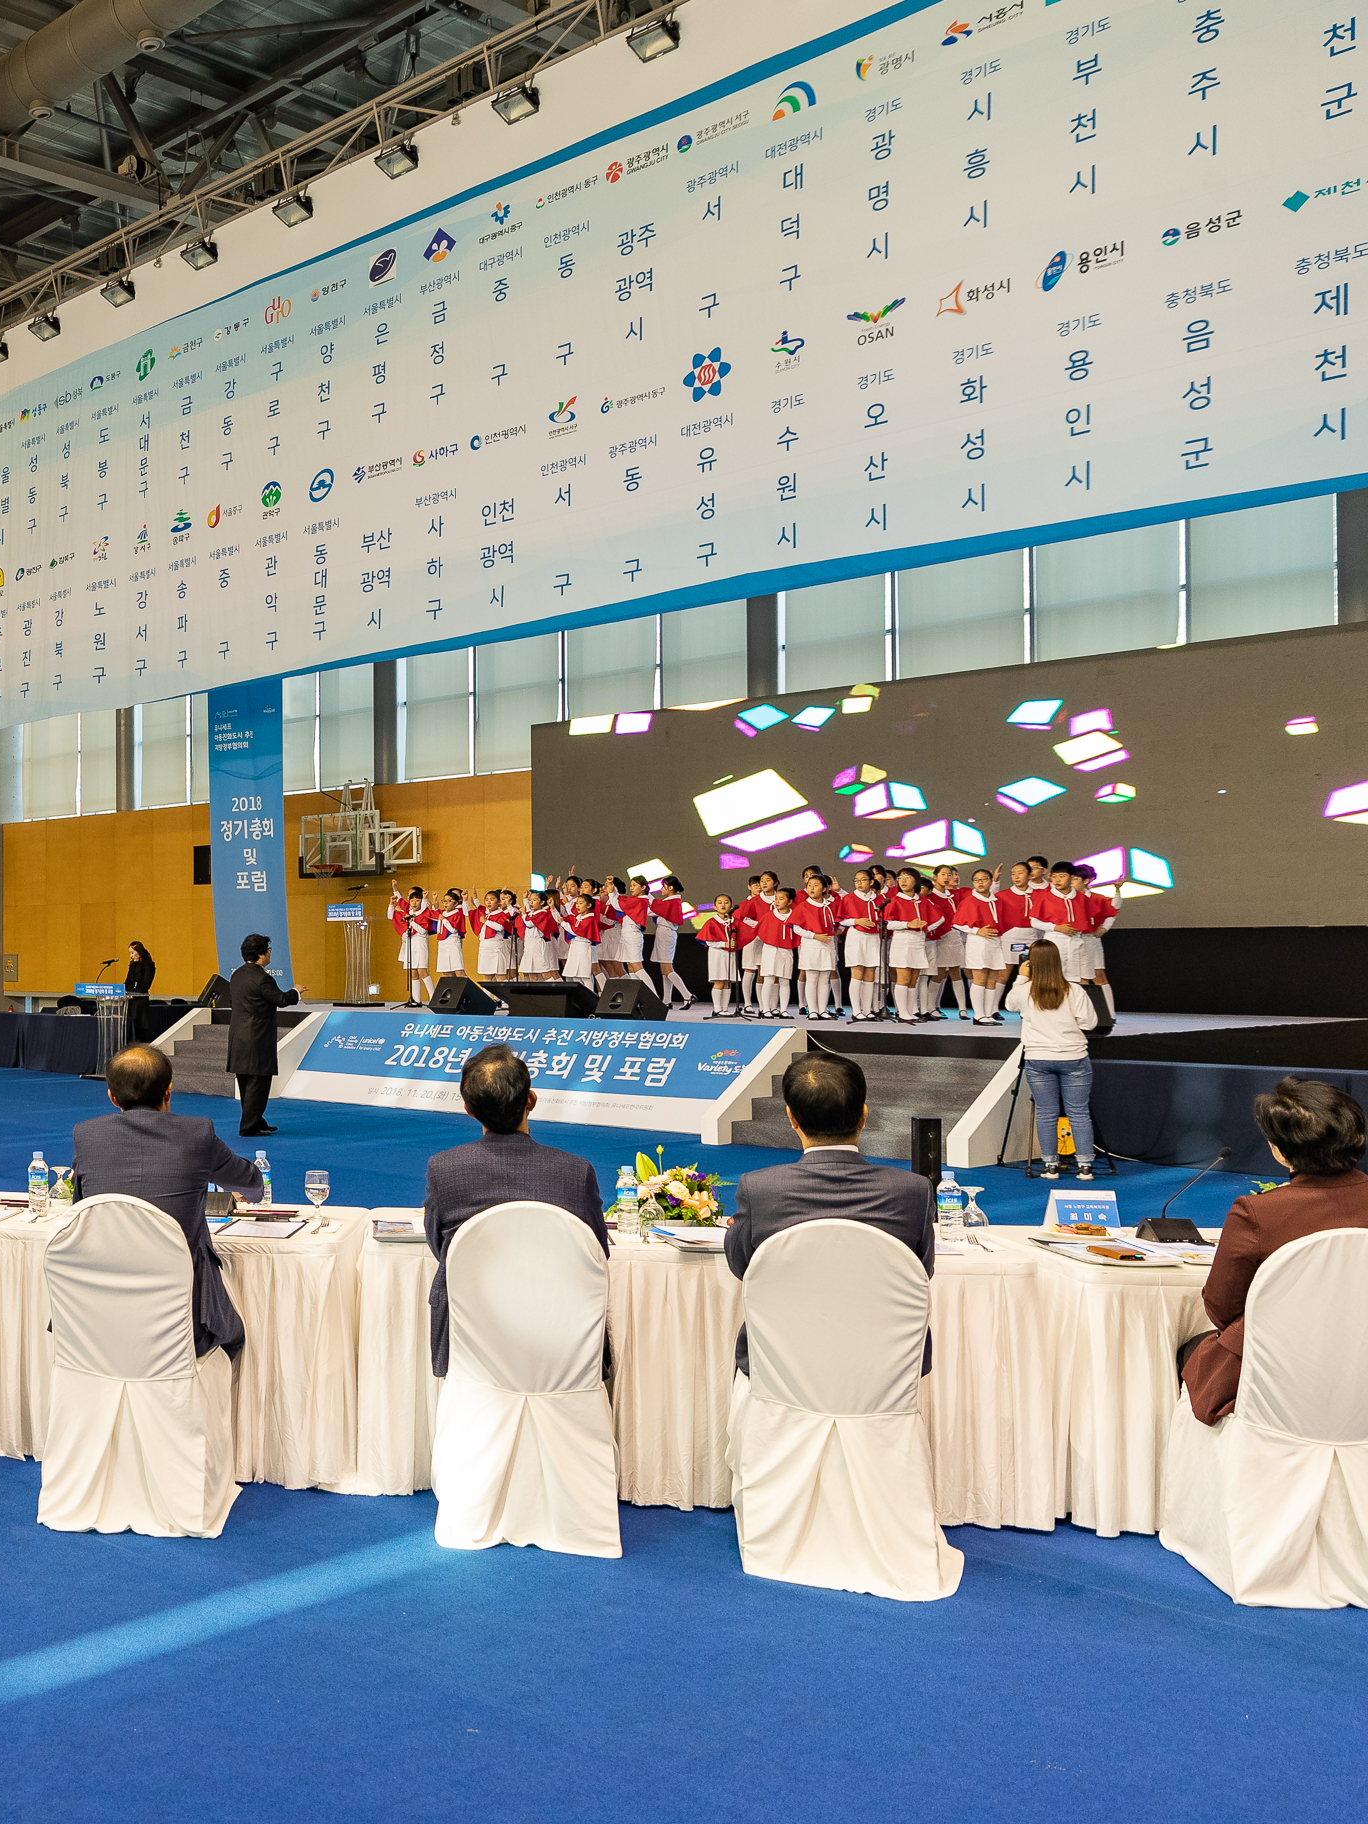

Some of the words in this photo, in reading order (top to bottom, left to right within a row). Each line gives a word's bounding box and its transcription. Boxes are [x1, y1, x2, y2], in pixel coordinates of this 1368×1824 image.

[1066, 16, 1112, 44] 경기도
[878, 50, 914, 75] 광명시
[960, 58, 1002, 86] 경기도
[1188, 8, 1226, 156] 충주시
[864, 98, 902, 122] 경기도
[1070, 54, 1102, 194] 부천시
[697, 117, 732, 139] 광주광역시
[735, 110, 749, 121] 서구
[627, 143, 668, 168] 광주광역시
[766, 126, 822, 158] 대전광역시
[627, 160, 655, 175] GWANGJU
[657, 154, 668, 163] CITY
[962, 92, 992, 228] 시흥시
[686, 160, 738, 194] 광주광역시
[1314, 178, 1368, 198] 제천
[866, 130, 896, 260] 광명시
[544, 220, 590, 248] 인천광역시
[616, 222, 656, 256] 광주
[780, 162, 804, 292] 대덕구
[1184, 210, 1242, 240] 음성군
[480, 246, 522, 272] 대구광역시
[698, 196, 720, 318] 서구
[1077, 240, 1124, 274] 용인시
[420, 270, 460, 296] 부산광역시
[614, 268, 652, 302] 광역
[966, 278, 1010, 302] 화성시
[1164, 278, 1232, 308] 충청북도
[362, 292, 402, 316] 서울특별시
[556, 252, 576, 366] 동구
[310, 314, 346, 336] 서울특별시
[490, 278, 510, 386] 중구
[626, 316, 642, 340] 시
[858, 326, 894, 345] OSAN
[1056, 312, 1102, 338] 경기도
[260, 334, 294, 354] 서울특별시
[430, 300, 448, 406] 금정구
[952, 342, 994, 364] 경기도
[216, 352, 246, 372] 서울특별시
[372, 322, 390, 424] 은평구
[1314, 282, 1348, 440] 제천시
[172, 370, 202, 390] 서울특별시
[316, 342, 334, 440] 양천구
[858, 368, 894, 390] 경기도
[132, 388, 158, 406] 서울특별시
[266, 362, 284, 456] 구로구
[772, 394, 806, 414] 경기도
[1180, 320, 1214, 470] 음성군
[56, 418, 80, 434] 서울특별시
[90, 404, 118, 420] 서울특별시
[222, 378, 236, 470] 강동구
[680, 412, 734, 438] 대전광역시
[1064, 350, 1094, 490] 용인시
[22, 432, 46, 450] 서울특별시
[178, 396, 194, 484] 금천구
[484, 424, 526, 444] 인천광역시
[608, 434, 656, 458] 광주광역시
[960, 374, 988, 512] 화성시
[138, 410, 150, 498] 서대문구
[368, 457, 402, 473] 부산광역시
[429, 444, 458, 460] 사하구
[540, 454, 586, 476] 인천광역시
[58, 440, 70, 522] 성북구
[96, 428, 110, 510] 도봉구
[864, 404, 888, 530] 오산시
[28, 454, 38, 534] 성동구
[414, 488, 456, 508] 부산광역시
[776, 426, 800, 548] 수원시
[482, 498, 514, 526] 인천
[696, 448, 718, 568] 유성구
[302, 518, 340, 536] 서울특별시
[622, 466, 642, 582] 동구
[208, 544, 240, 560] 서울특별시
[254, 530, 288, 548] 서울특별시
[360, 528, 392, 554] 부산
[554, 484, 572, 596] 서구
[168, 556, 196, 572] 서울특별시
[426, 516, 444, 620] 사하구
[480, 540, 514, 568] 광역
[86, 578, 116, 592] 서울특별시
[128, 568, 156, 582] 서울특별시
[360, 566, 390, 592] 광역
[16, 598, 40, 612] 서울특별시
[48, 586, 72, 602] 서울특별시
[264, 556, 278, 650] 관악구
[312, 544, 328, 640] 동대문구
[490, 584, 504, 608] 시
[176, 580, 188, 668] 송파구
[218, 568, 230, 660] 중구
[368, 608, 382, 630] 시
[92, 602, 106, 684] 노원구
[134, 590, 148, 676] 강서구
[20, 618, 32, 698] 광진구
[52, 608, 64, 690] 강북구
[232, 796, 262, 812] 2018
[221, 818, 274, 842] 정기총회
[244, 848, 257, 865] 및
[236, 871, 267, 892] 포럼
[401, 1023, 453, 1038] 유니세프
[456, 1025, 541, 1044] 아동친화도시
[542, 1028, 574, 1046] 추진
[575, 1030, 689, 1049] 지방정부협의회
[384, 1044, 472, 1073] 2018년
[581, 1055, 612, 1083] 및
[613, 1056, 676, 1087] 포럼
[698, 1062, 732, 1075] Variety
